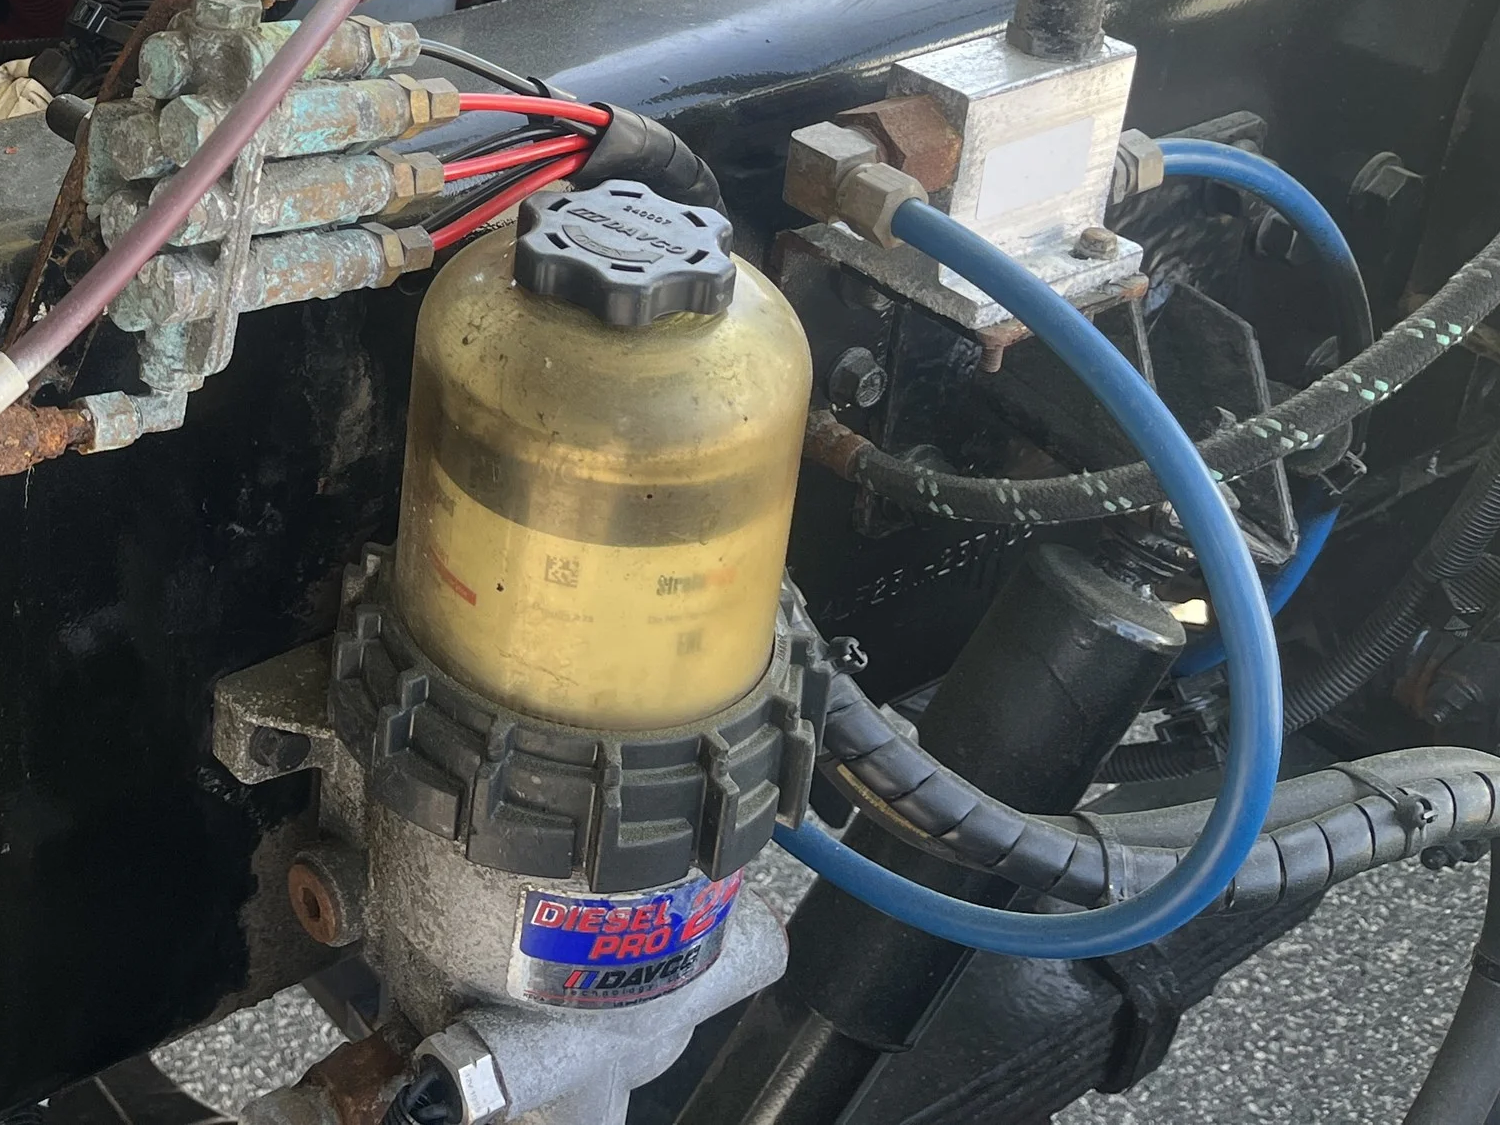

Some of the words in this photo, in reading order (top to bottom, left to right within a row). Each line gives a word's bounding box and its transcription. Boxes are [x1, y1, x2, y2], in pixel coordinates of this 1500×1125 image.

[622, 205, 672, 225] 240007
[573, 233, 621, 257] OPEN
[602, 220, 688, 254] DAVCO
[531, 898, 672, 934] DIESEL
[588, 924, 672, 961] PRO
